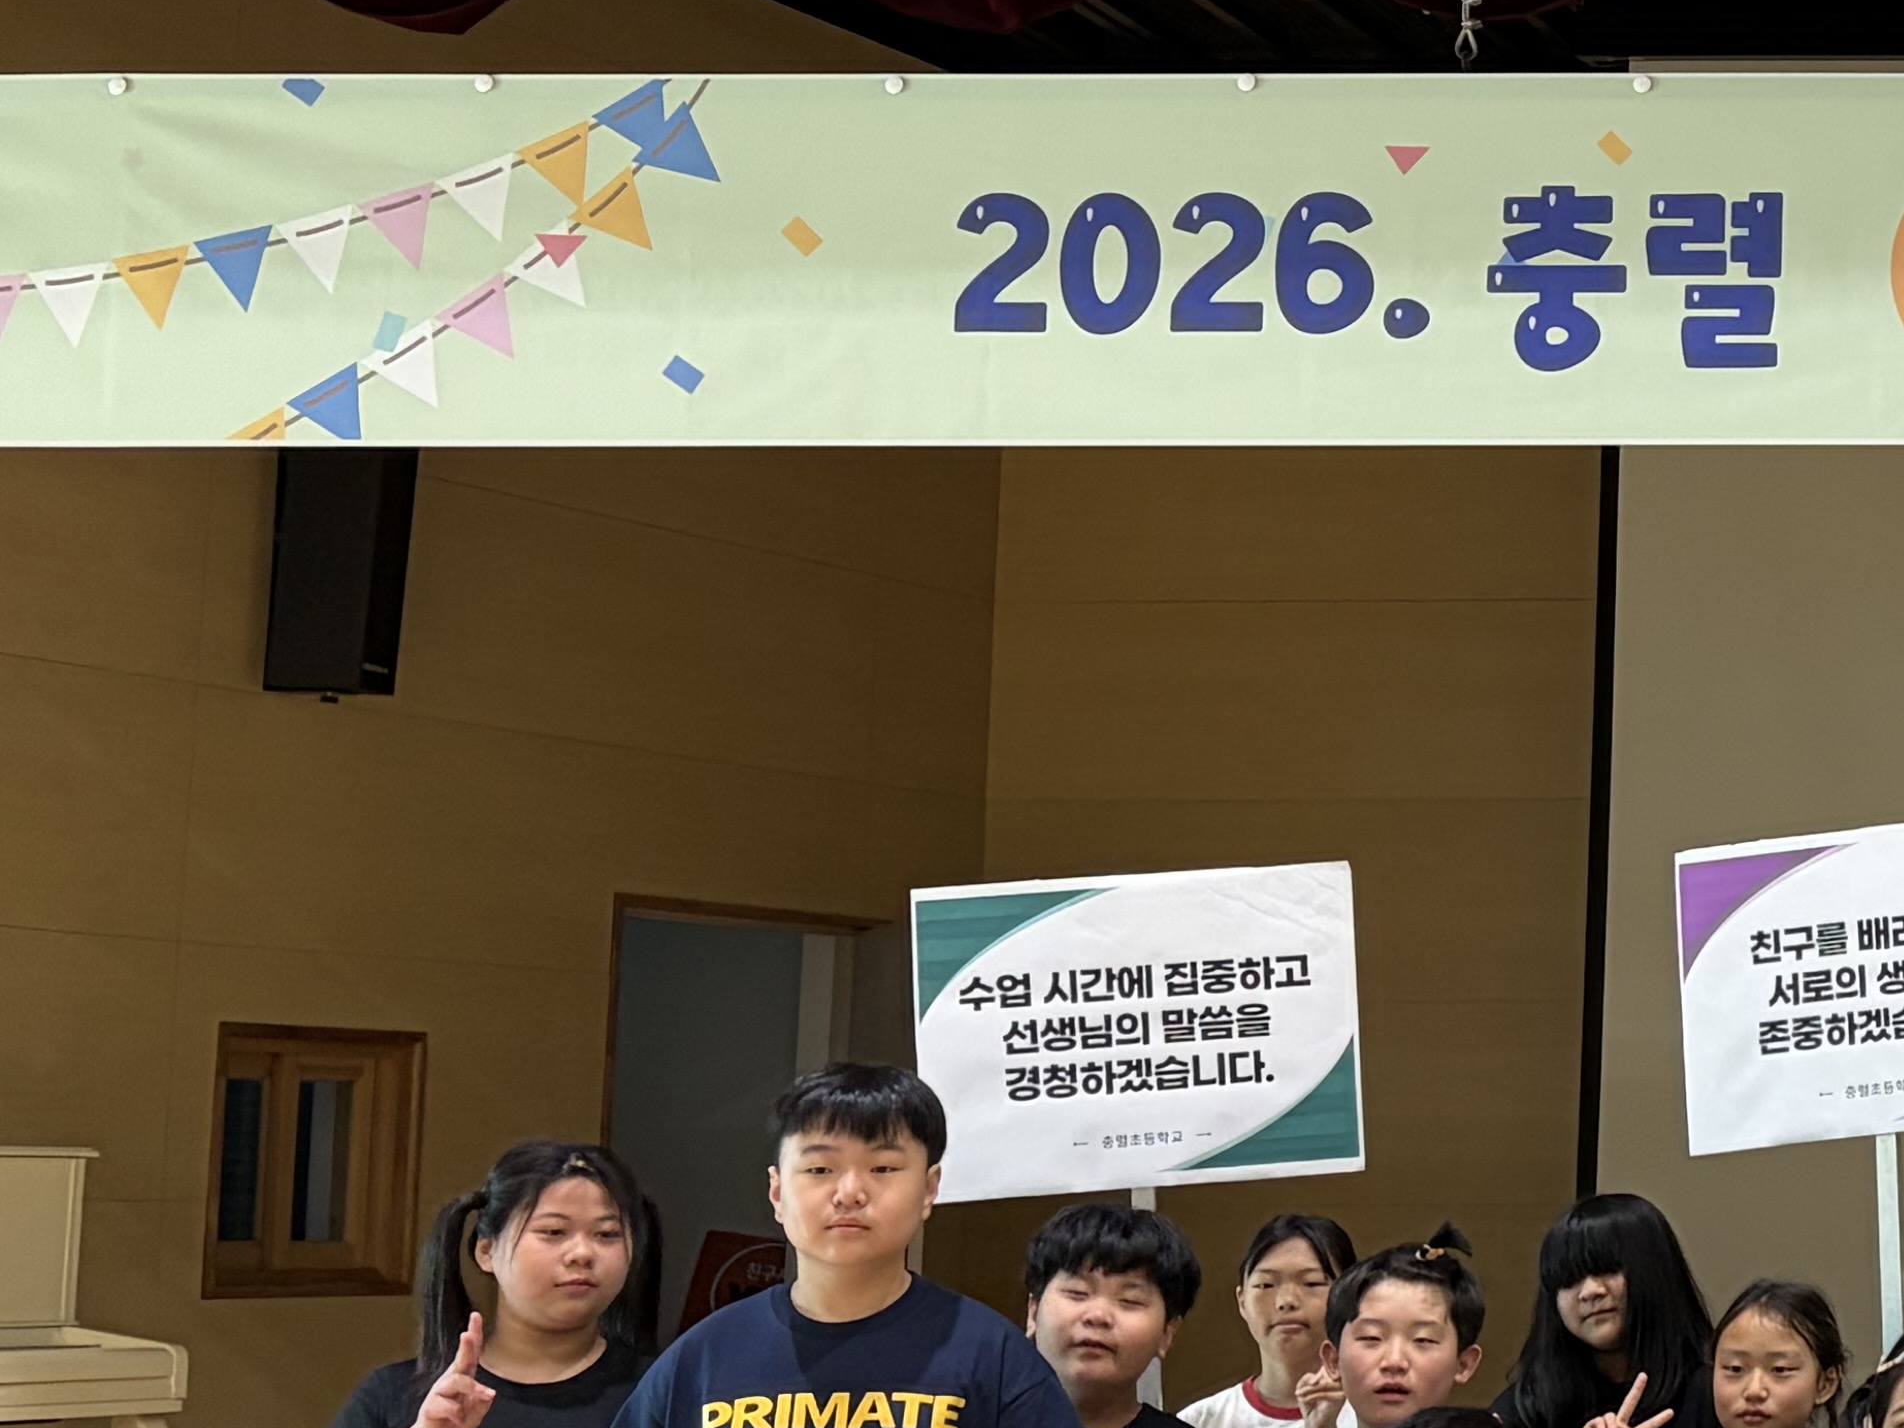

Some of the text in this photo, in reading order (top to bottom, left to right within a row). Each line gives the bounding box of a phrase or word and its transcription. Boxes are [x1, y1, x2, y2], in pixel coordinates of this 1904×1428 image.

[953, 190, 1431, 340] 2026.
[1486, 185, 1784, 372] 충렬
[1750, 921, 1849, 966] 친구를
[958, 954, 1312, 1012] 수업 시간에 집중하고
[1769, 964, 1868, 1009] 서로의
[1002, 1003, 1271, 1055] 선생님의 말씀을
[1004, 1050, 1275, 1102] 경청하겠습니다.
